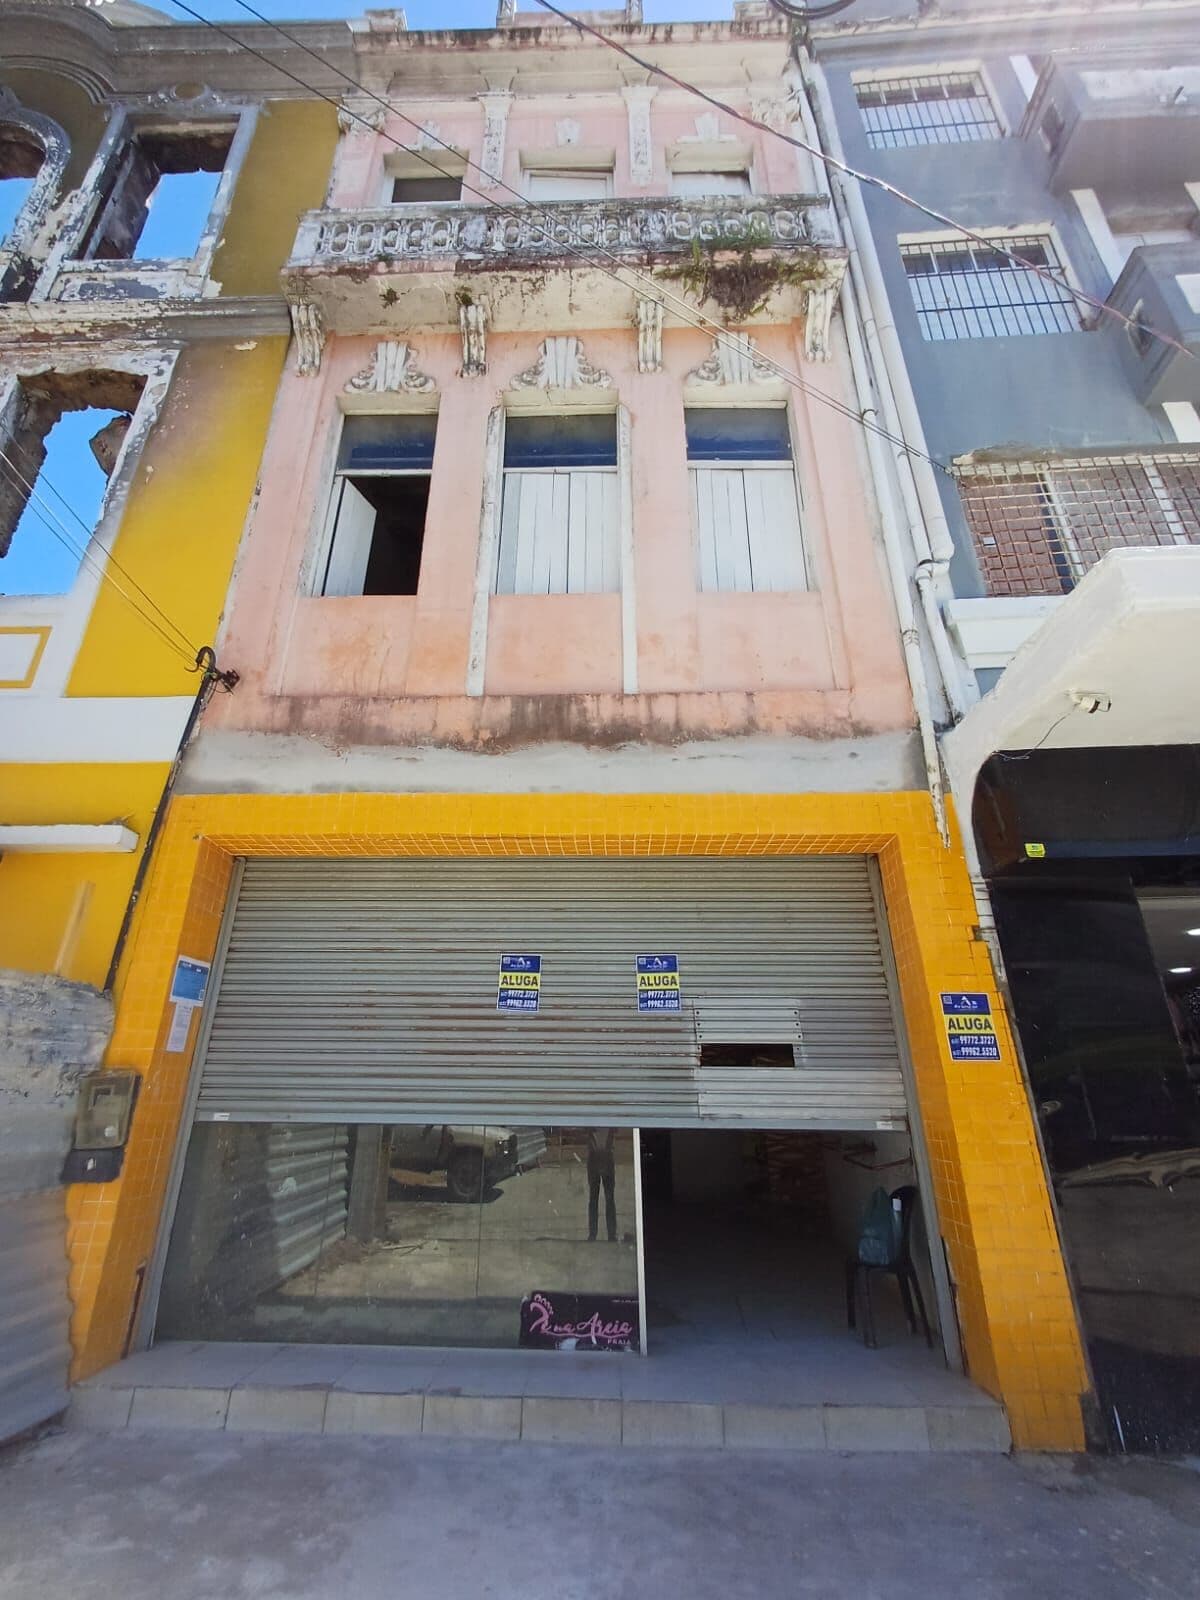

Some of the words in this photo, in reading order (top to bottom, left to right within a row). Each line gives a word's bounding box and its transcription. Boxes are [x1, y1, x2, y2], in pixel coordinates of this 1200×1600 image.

[501, 975, 538, 986] ALUGA
[640, 975, 678, 986] ALUGA
[948, 1018, 993, 1031] ALUGA
